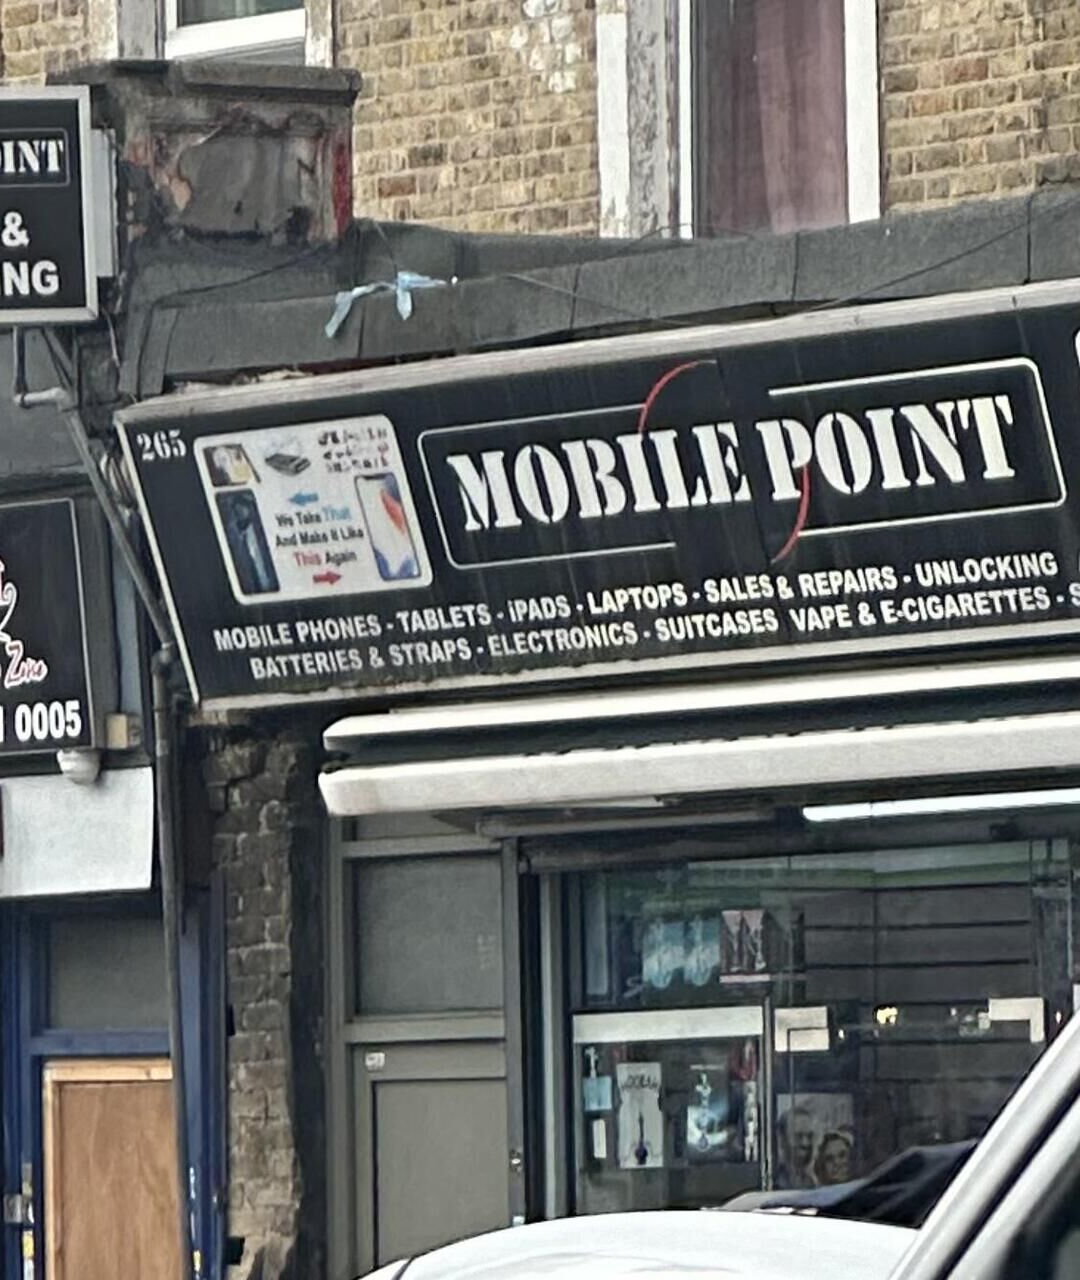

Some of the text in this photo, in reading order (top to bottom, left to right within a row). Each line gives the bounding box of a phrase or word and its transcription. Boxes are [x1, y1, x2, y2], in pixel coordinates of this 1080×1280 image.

[1, 211, 30, 247] &
[136, 430, 186, 461] 265
[447, 421, 751, 531] MOBILE
[756, 395, 1015, 501] POINT
[276, 532, 297, 546] And
[299, 531, 328, 545] Make
[340, 526, 364, 540] Like
[296, 511, 321, 525] Take
[325, 549, 357, 566] Again
[213, 622, 294, 651] MOBILE
[296, 614, 382, 643] PHONES
[396, 603, 492, 633] TABLETS
[507, 595, 571, 623] iPADS
[586, 583, 688, 615] LAPTOPS
[704, 574, 774, 604] SALES
[776, 575, 795, 600] &
[799, 566, 898, 599] REPAIRS
[914, 551, 1059, 588] UNLOCKING
[249, 648, 363, 681] BATTERIES
[369, 646, 385, 669] &
[390, 637, 472, 667] STRAPS
[487, 621, 638, 657] ELECTRONICS
[655, 609, 780, 643] SUITCASES
[789, 604, 853, 633] VAPE
[858, 602, 876, 626] &
[880, 586, 1051, 625] E-CIGARETTES
[4, 640, 49, 688] Zone
[15, 700, 82, 742] 0005
